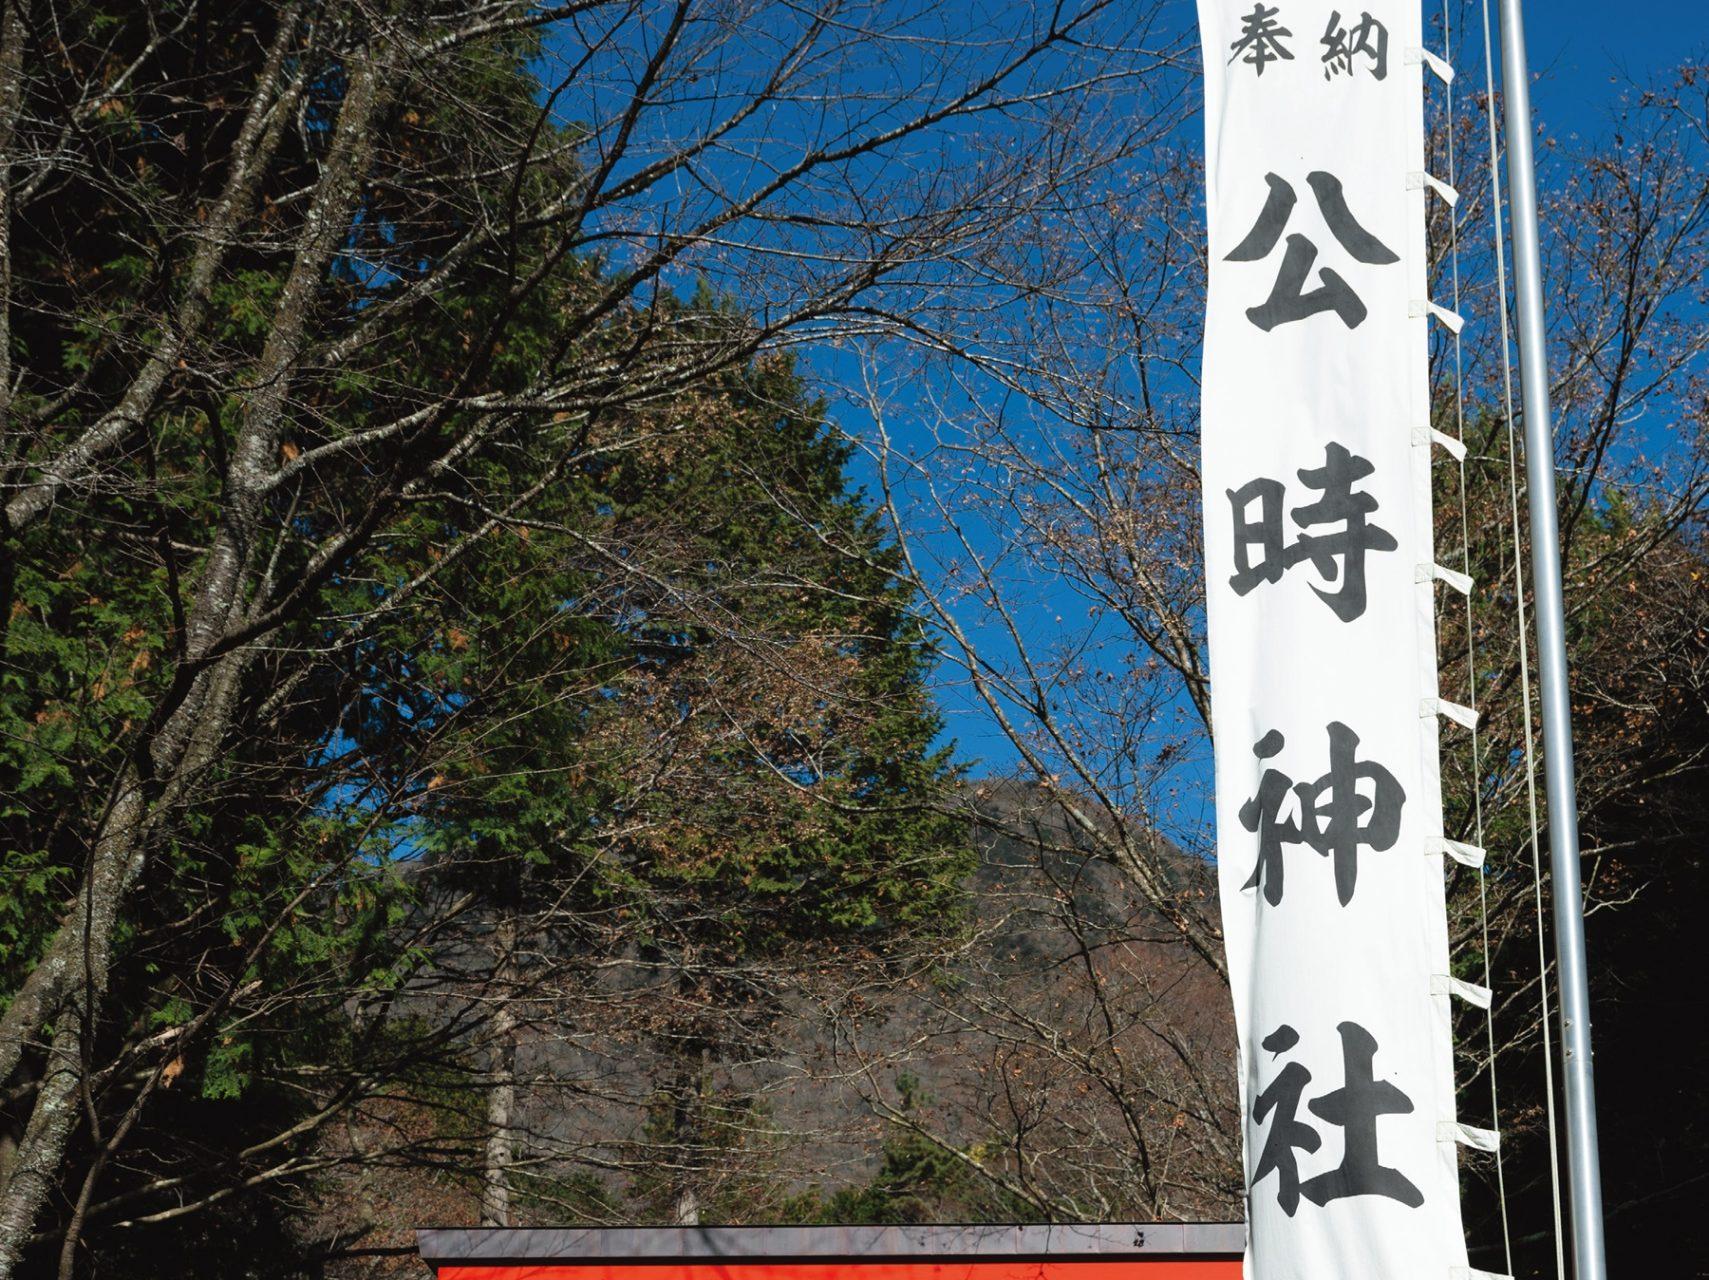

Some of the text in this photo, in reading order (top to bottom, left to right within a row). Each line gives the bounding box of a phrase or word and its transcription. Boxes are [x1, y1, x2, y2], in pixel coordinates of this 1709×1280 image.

[1228, 3, 1389, 81] 奉納
[1224, 171, 1425, 1218] 公時神社
